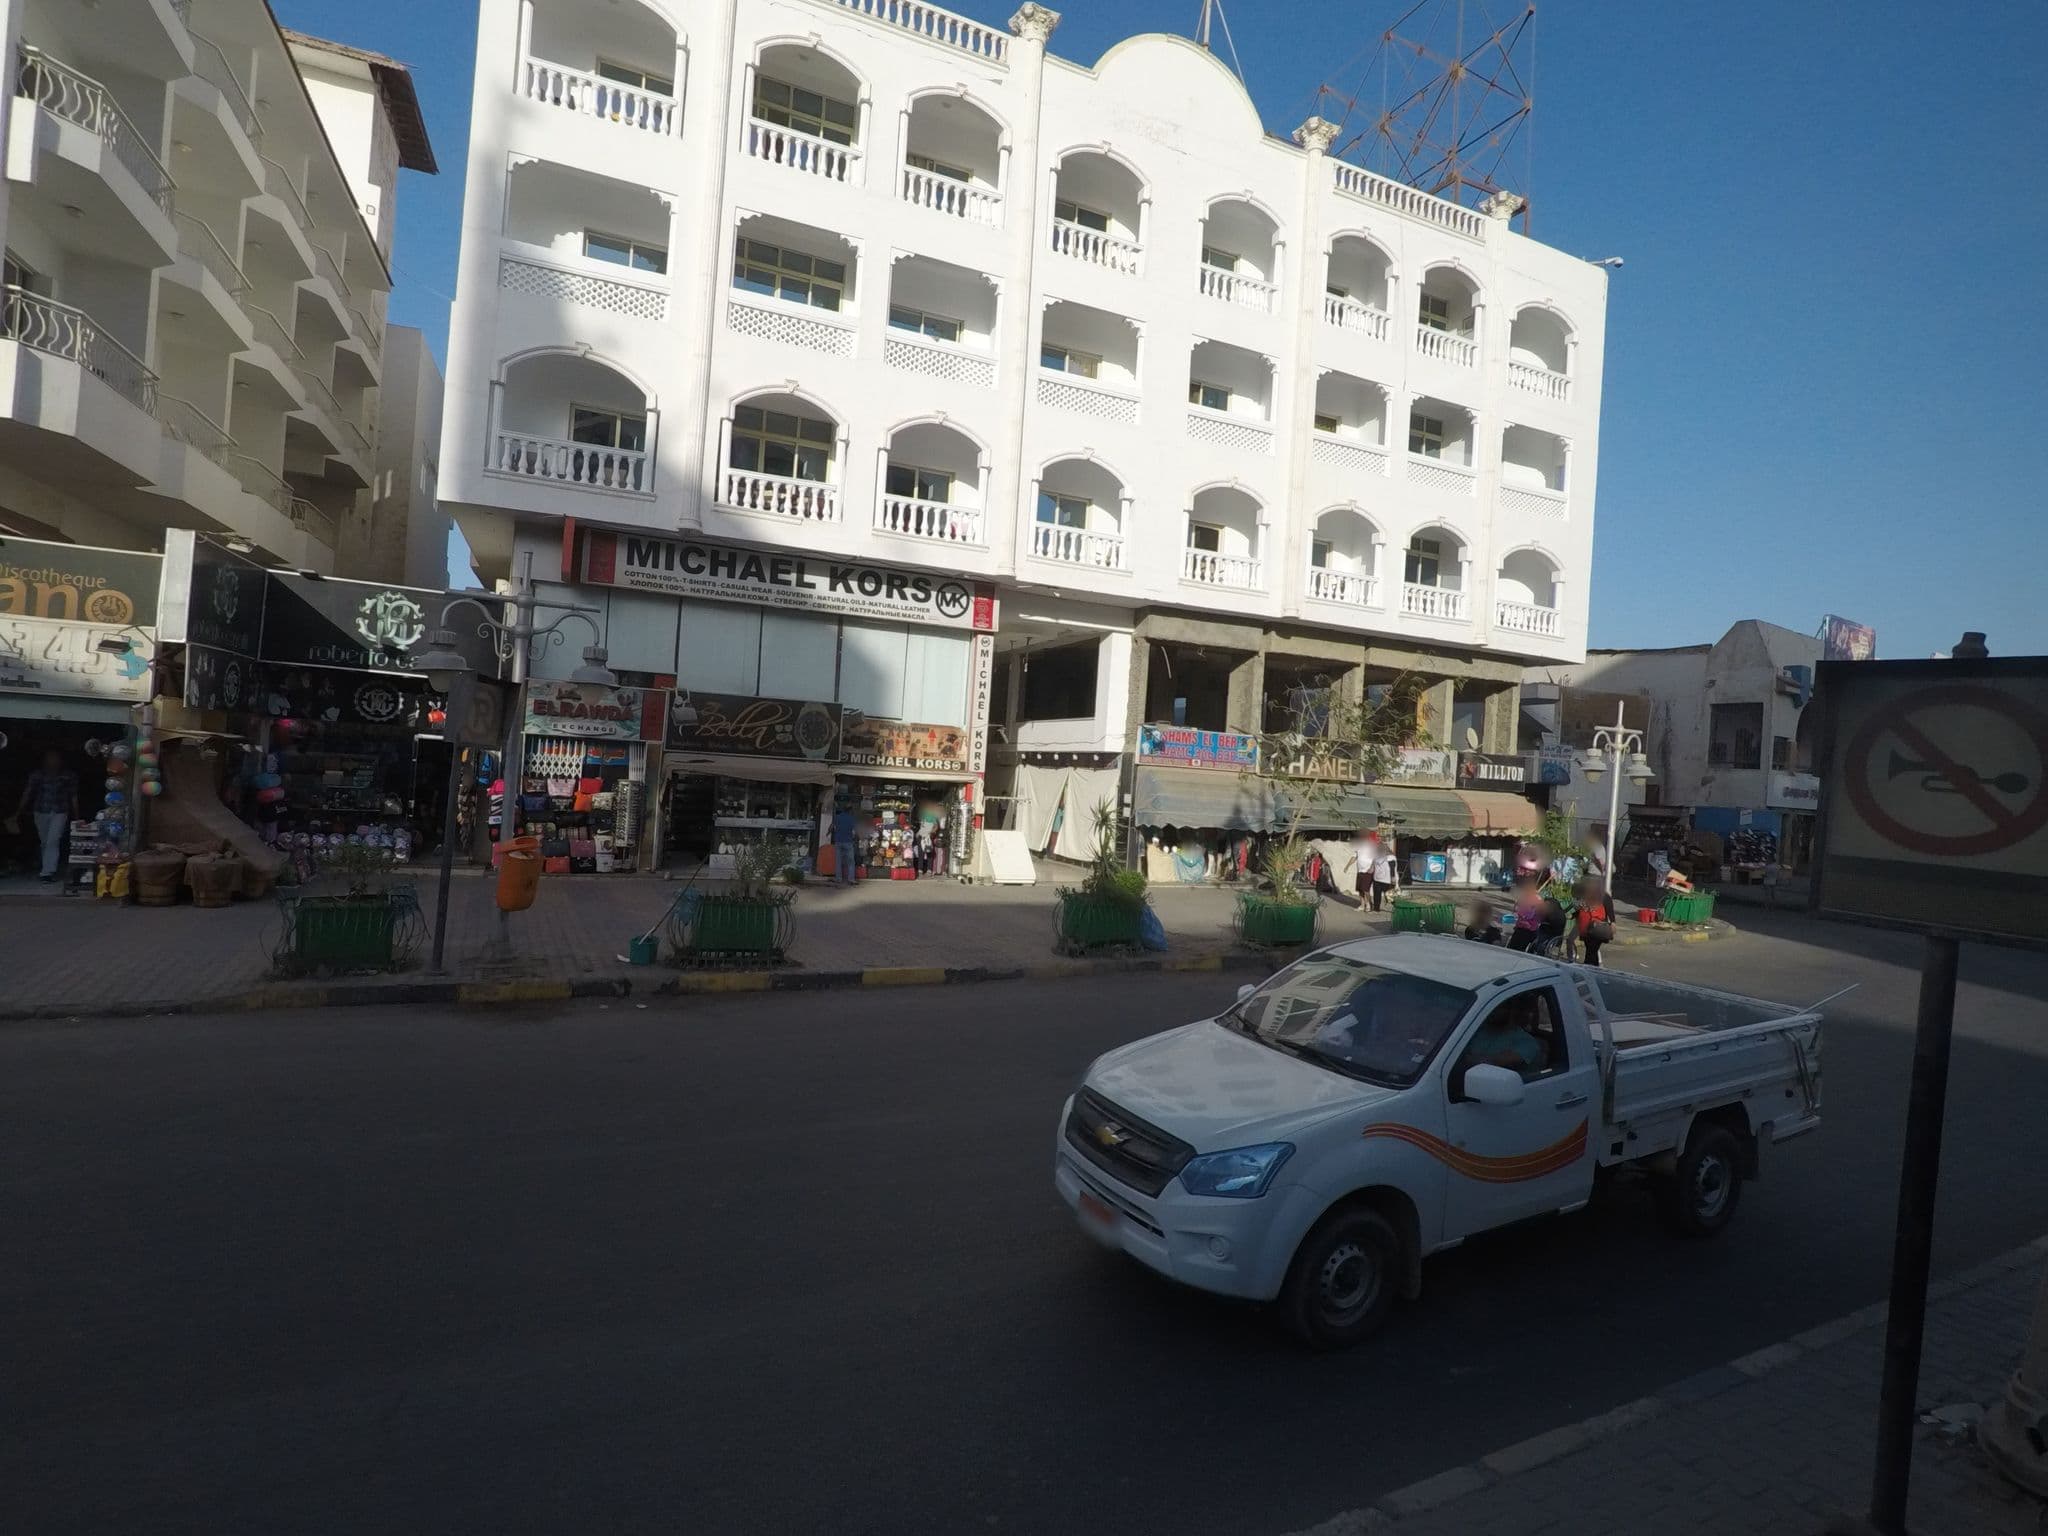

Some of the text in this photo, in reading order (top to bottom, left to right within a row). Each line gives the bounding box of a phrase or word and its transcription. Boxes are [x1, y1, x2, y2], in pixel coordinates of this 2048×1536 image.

[626, 537, 968, 612] MICHAEL KORS MK
[624, 570, 657, 581] COTTON
[658, 574, 680, 583] 100%
[720, 582, 750, 592] CASUAL
[751, 586, 773, 595] WEAR
[775, 589, 814, 600] SOUVENIR
[817, 595, 850, 605] NATURAL
[850, 598, 866, 606] OILS
[868, 600, 900, 610] NATURAL
[900, 603, 931, 614] LEATHER
[629, 579, 664, 590] ХЛОПОК
[665, 583, 686, 592] 100%
[973, 649, 990, 771] MICHAEL KORS
[553, 723, 614, 733] EXCHANGE
[1161, 730, 1237, 748] SHAMS EL BER
[850, 753, 911, 768] MICHAEL
[915, 758, 952, 770] KORS
[1270, 753, 1358, 780] HANEL
[1478, 763, 1525, 782] MILLION
